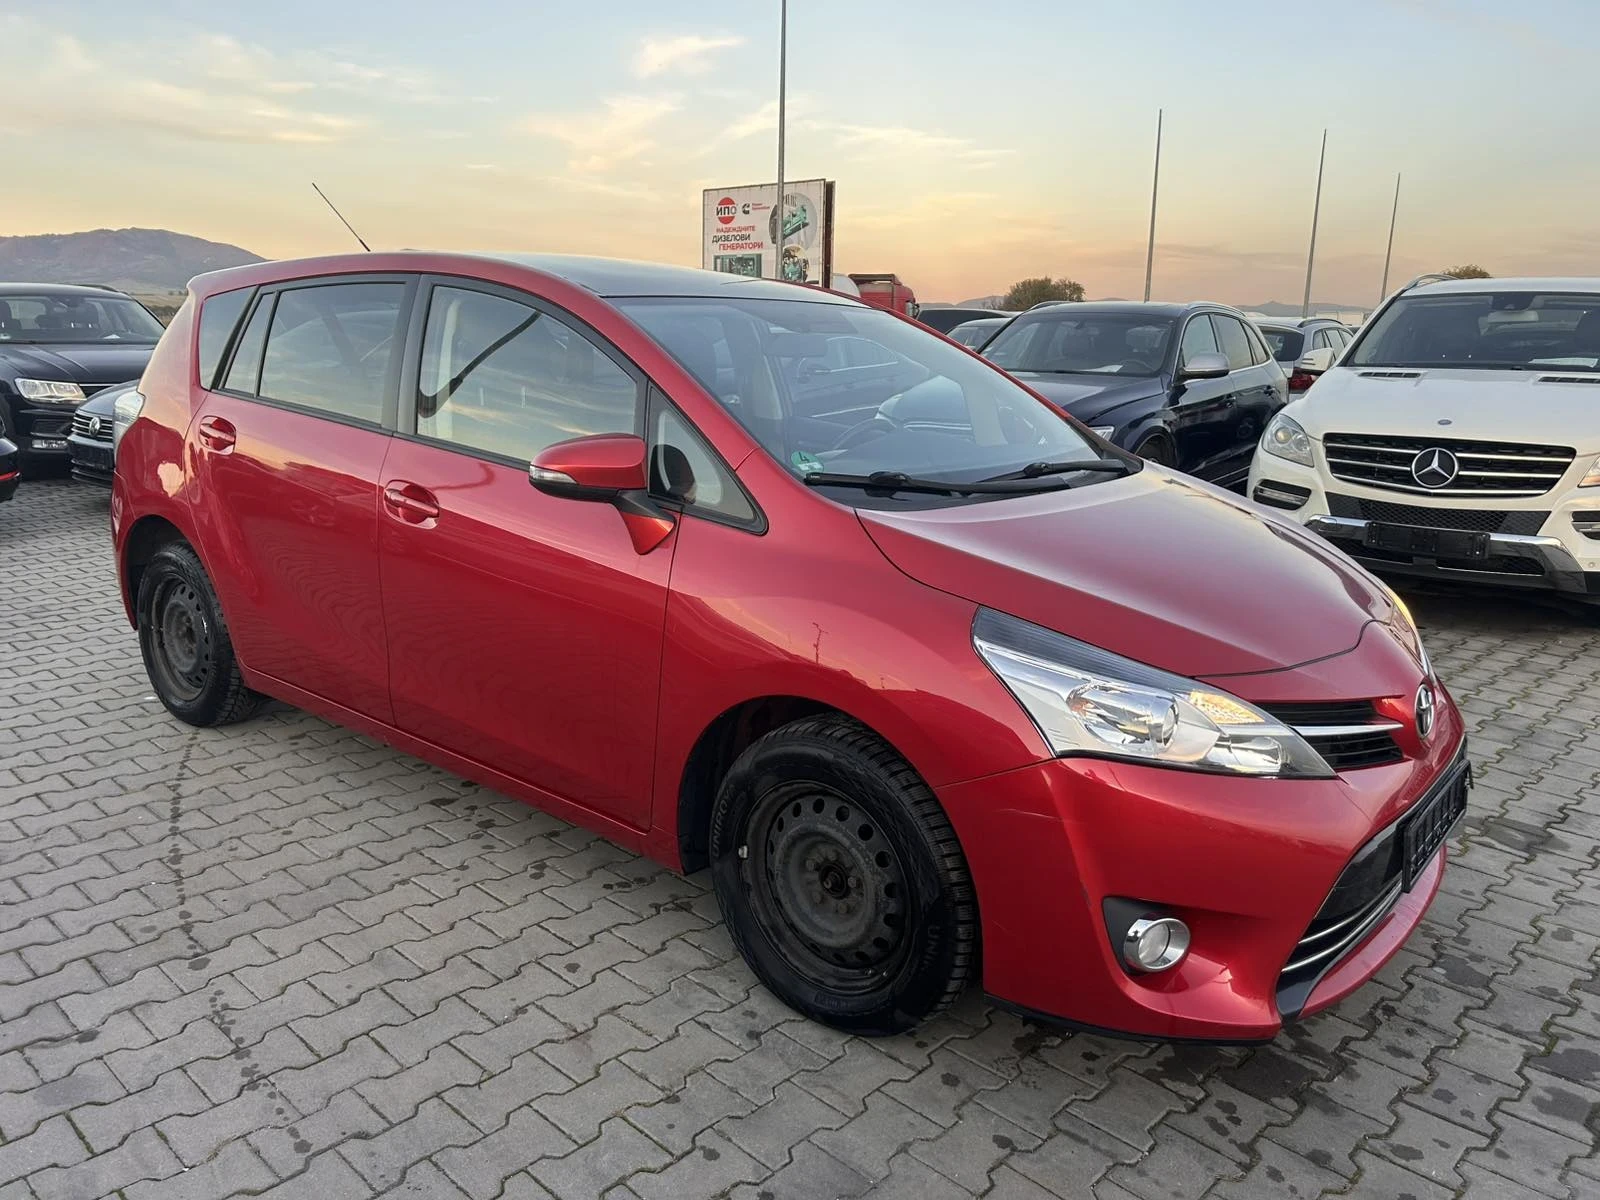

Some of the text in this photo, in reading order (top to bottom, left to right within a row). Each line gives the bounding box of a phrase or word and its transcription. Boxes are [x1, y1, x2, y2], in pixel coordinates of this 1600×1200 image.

[716, 206, 737, 216] ИПО
[712, 233, 751, 243] ДИЗЕЛОВИ
[719, 241, 763, 251] ГЕНЕРАТОРИ
